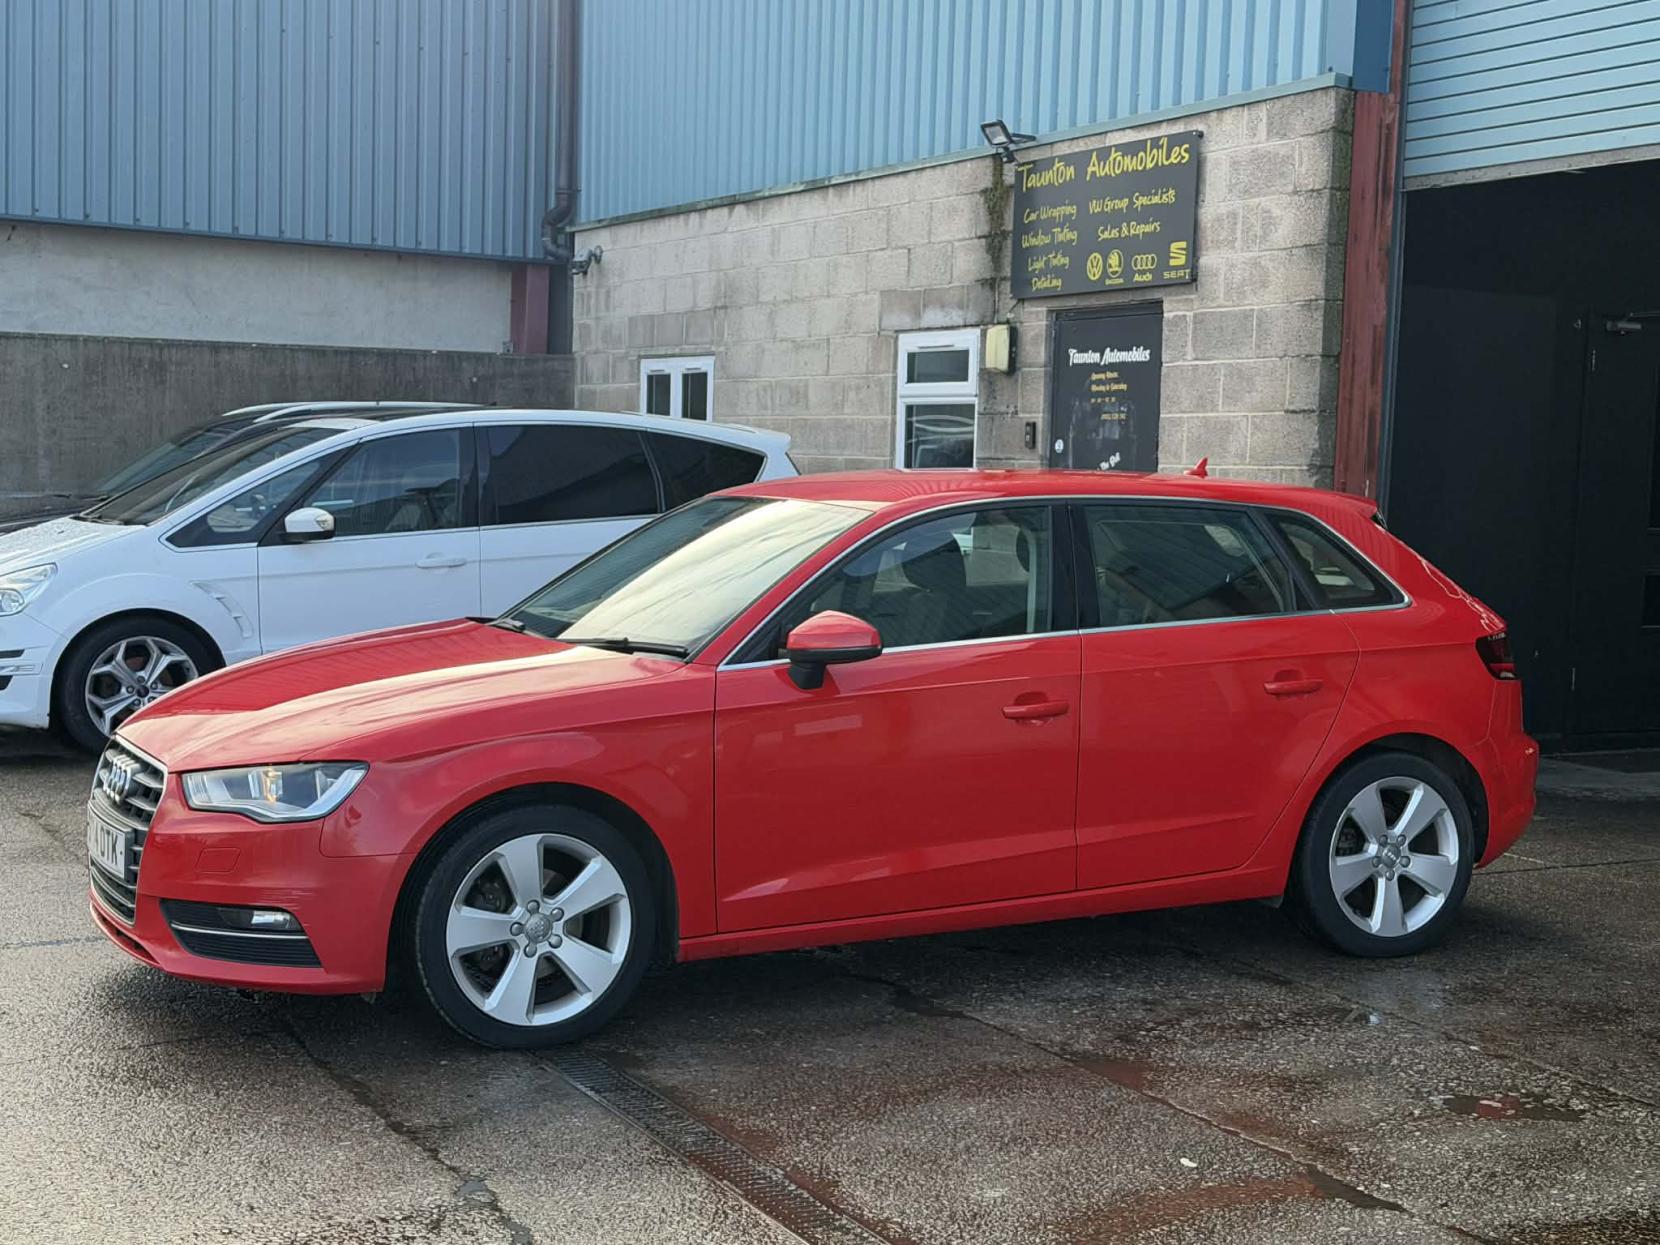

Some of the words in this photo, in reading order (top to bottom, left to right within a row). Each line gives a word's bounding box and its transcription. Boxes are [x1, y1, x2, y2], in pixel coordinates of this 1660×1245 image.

[1017, 157, 1076, 192] Taunton
[1086, 137, 1190, 181] Automobiles
[1024, 208, 1039, 224] Car
[1040, 200, 1077, 222] Wrapping
[1089, 200, 1103, 215] VW
[1103, 196, 1129, 213] Group
[1133, 187, 1176, 212] Specialists
[1022, 227, 1051, 248] Window
[1051, 222, 1078, 246] Tinting
[1098, 223, 1120, 241] Sales
[1121, 222, 1130, 238] &
[1130, 217, 1160, 241] Repairs
[1133, 272, 1153, 282] Audi
[1163, 269, 1191, 280] SEAT
[1100, 346, 1151, 366] Automobiles
